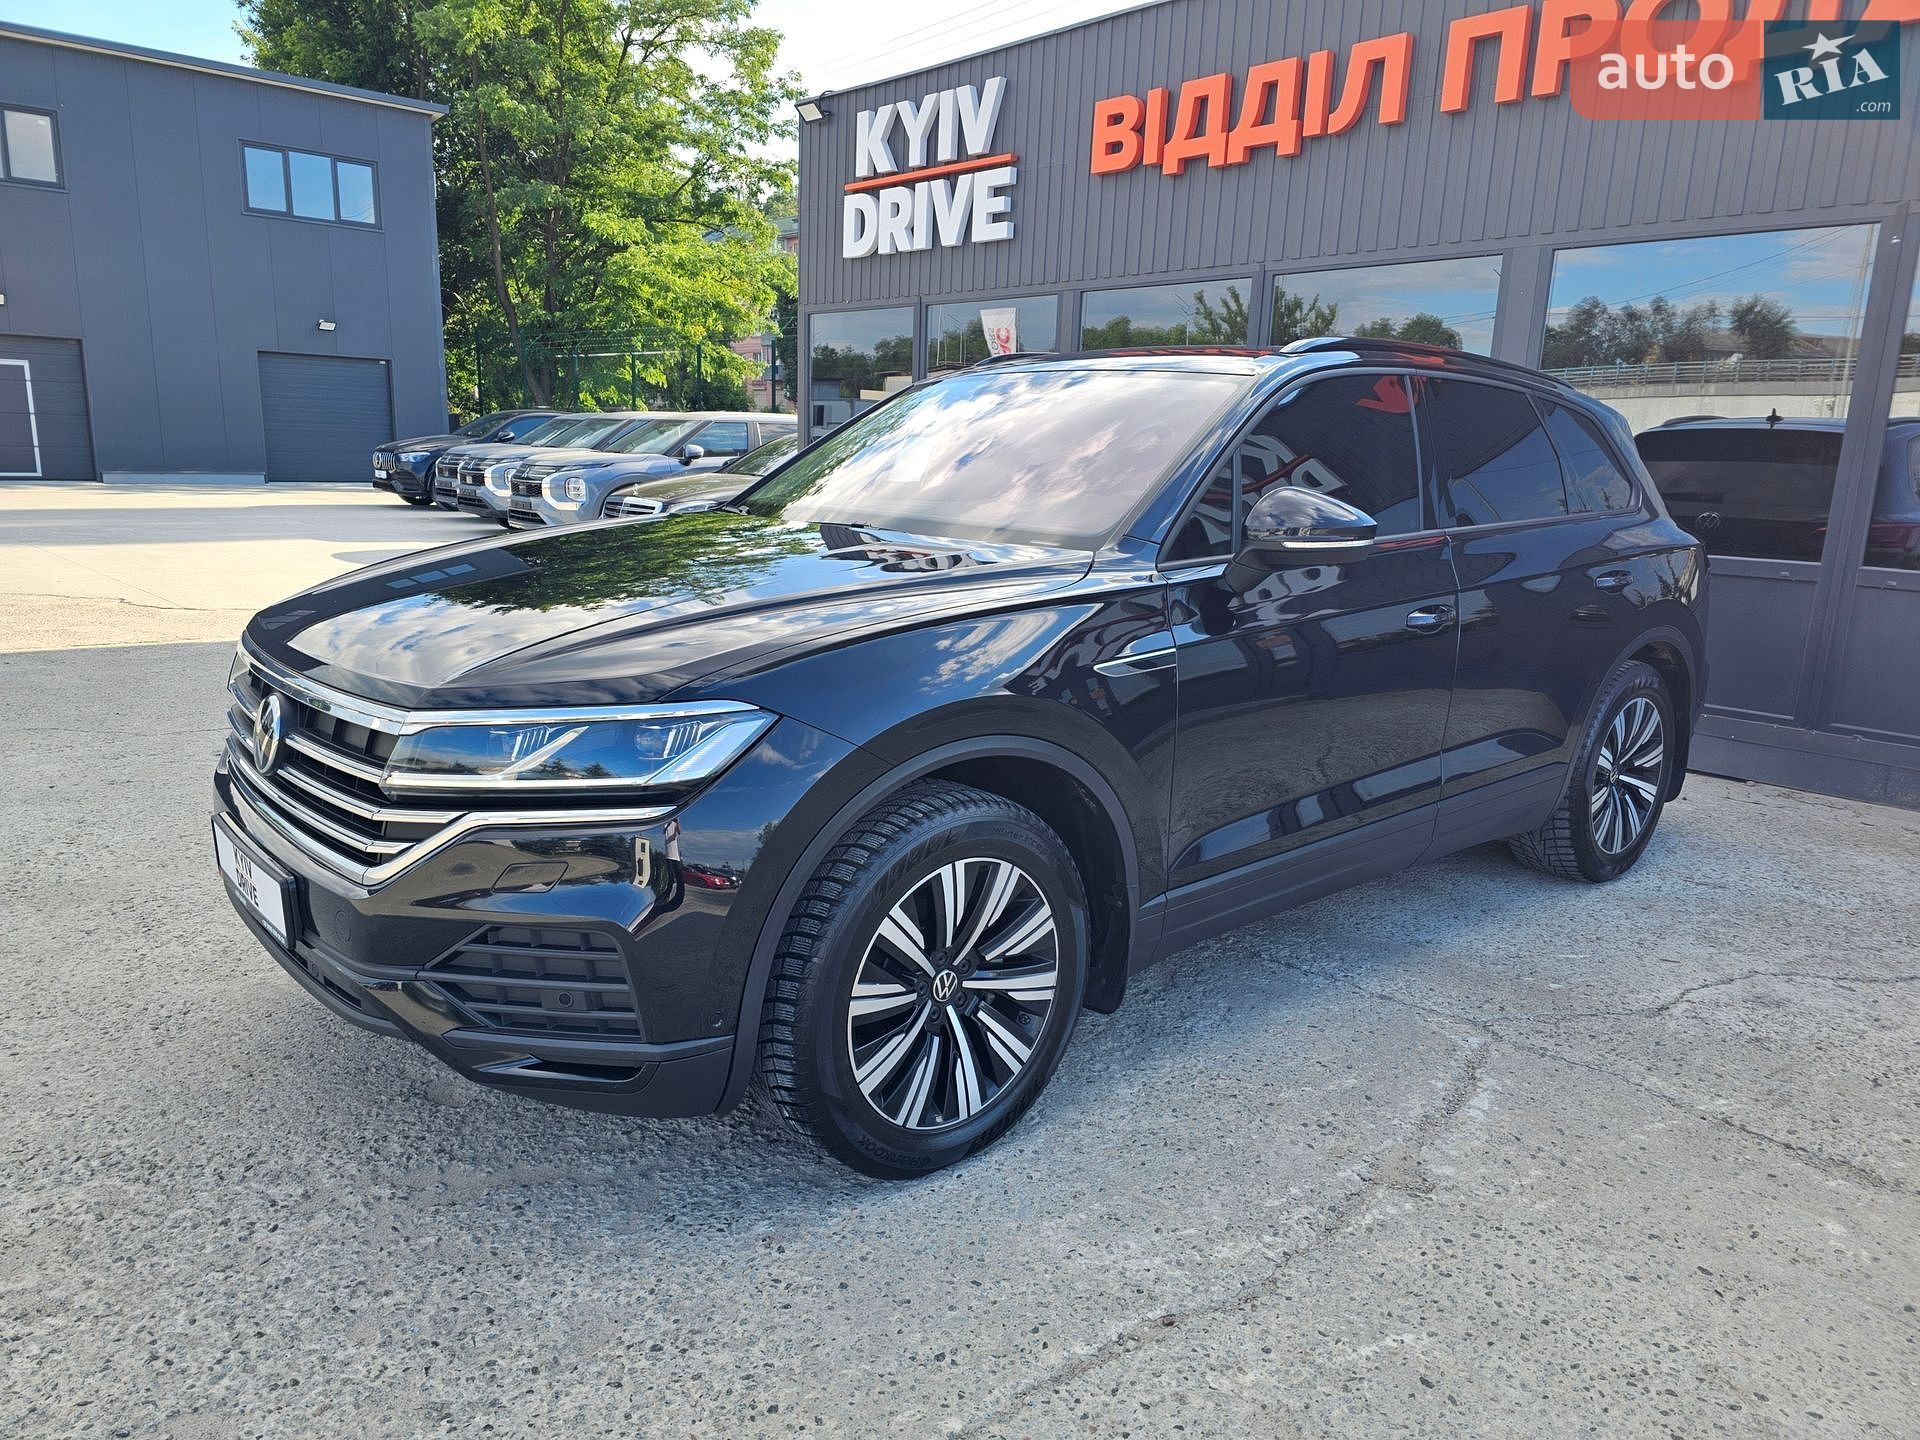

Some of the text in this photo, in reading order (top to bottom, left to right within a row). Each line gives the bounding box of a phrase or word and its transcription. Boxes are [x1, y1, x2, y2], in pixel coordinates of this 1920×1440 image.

[855, 76, 1007, 178] KYIV
[1091, 32, 1414, 176] ВІДДІЛ
[843, 166, 1018, 259] DRIVE
[235, 867, 260, 908] DRIVE
